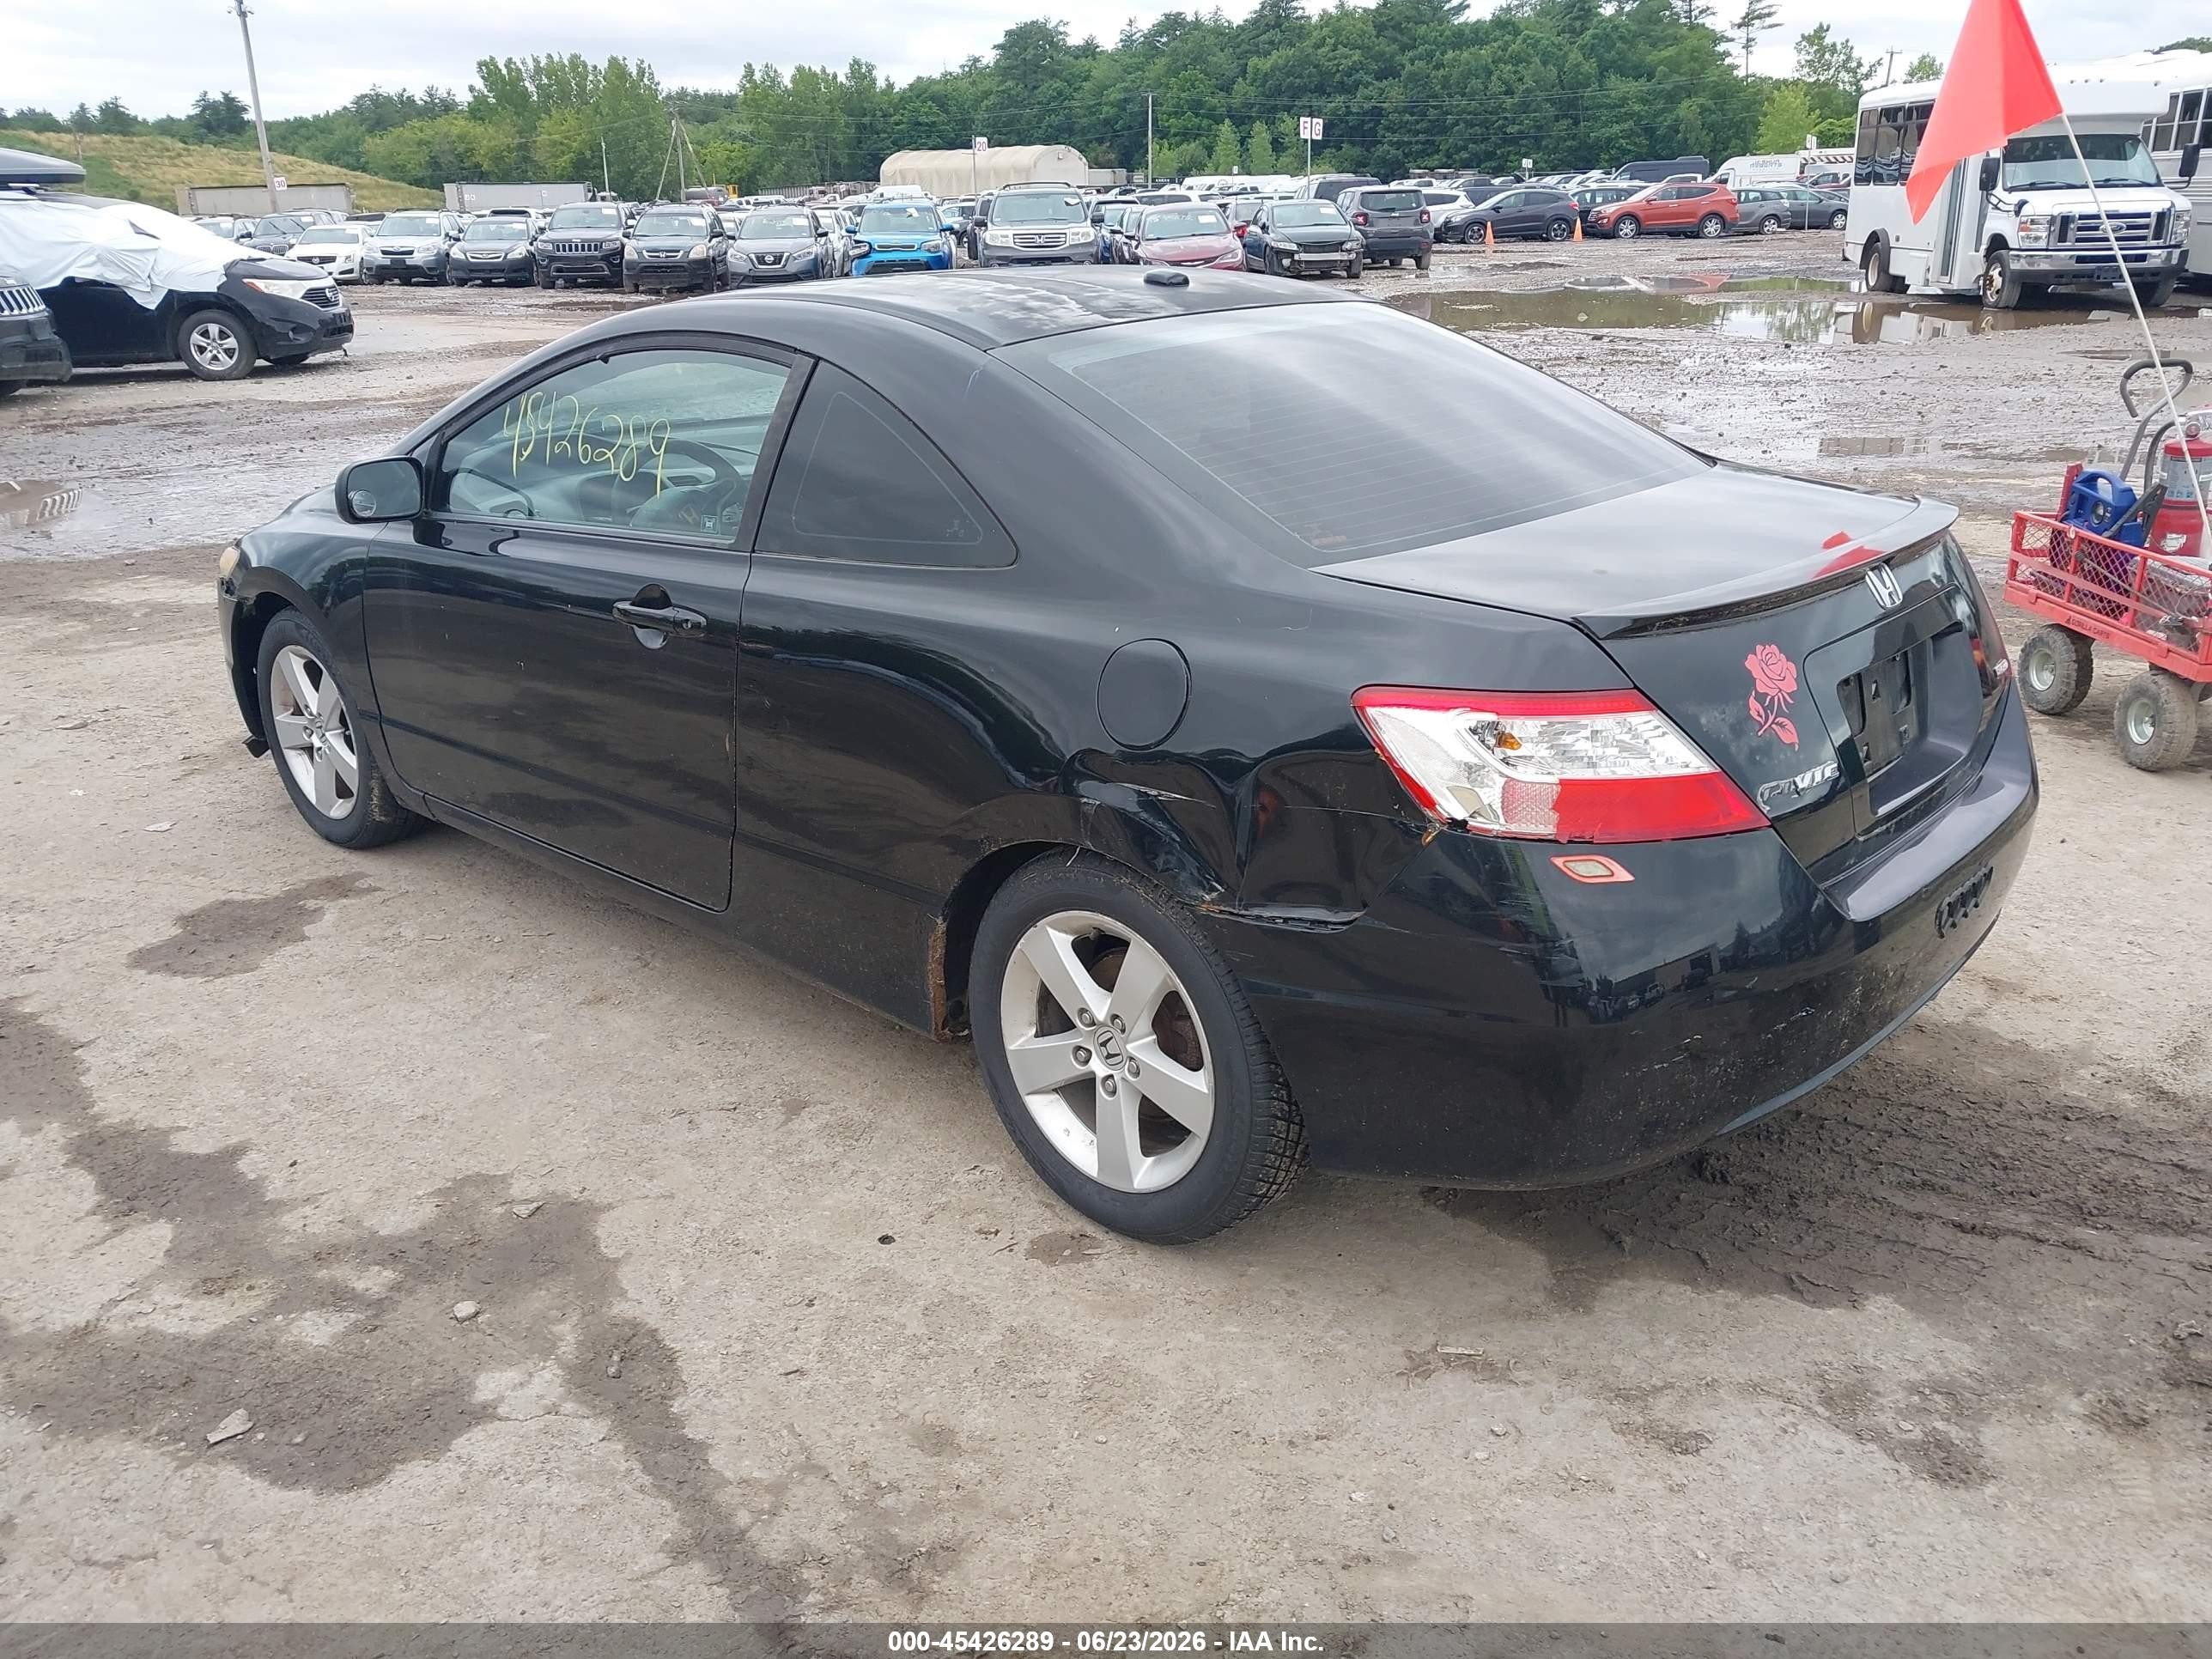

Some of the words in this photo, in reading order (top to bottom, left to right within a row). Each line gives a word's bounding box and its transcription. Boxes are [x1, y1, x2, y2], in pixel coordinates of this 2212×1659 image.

[1303, 120, 1309, 136] F
[1314, 121, 1322, 137] G
[976, 141, 987, 152] 20
[275, 179, 286, 188] 30
[2071, 617, 2092, 631] GORILLA
[2093, 627, 2110, 639] CARTS
[1757, 760, 1840, 812] CIVIC
